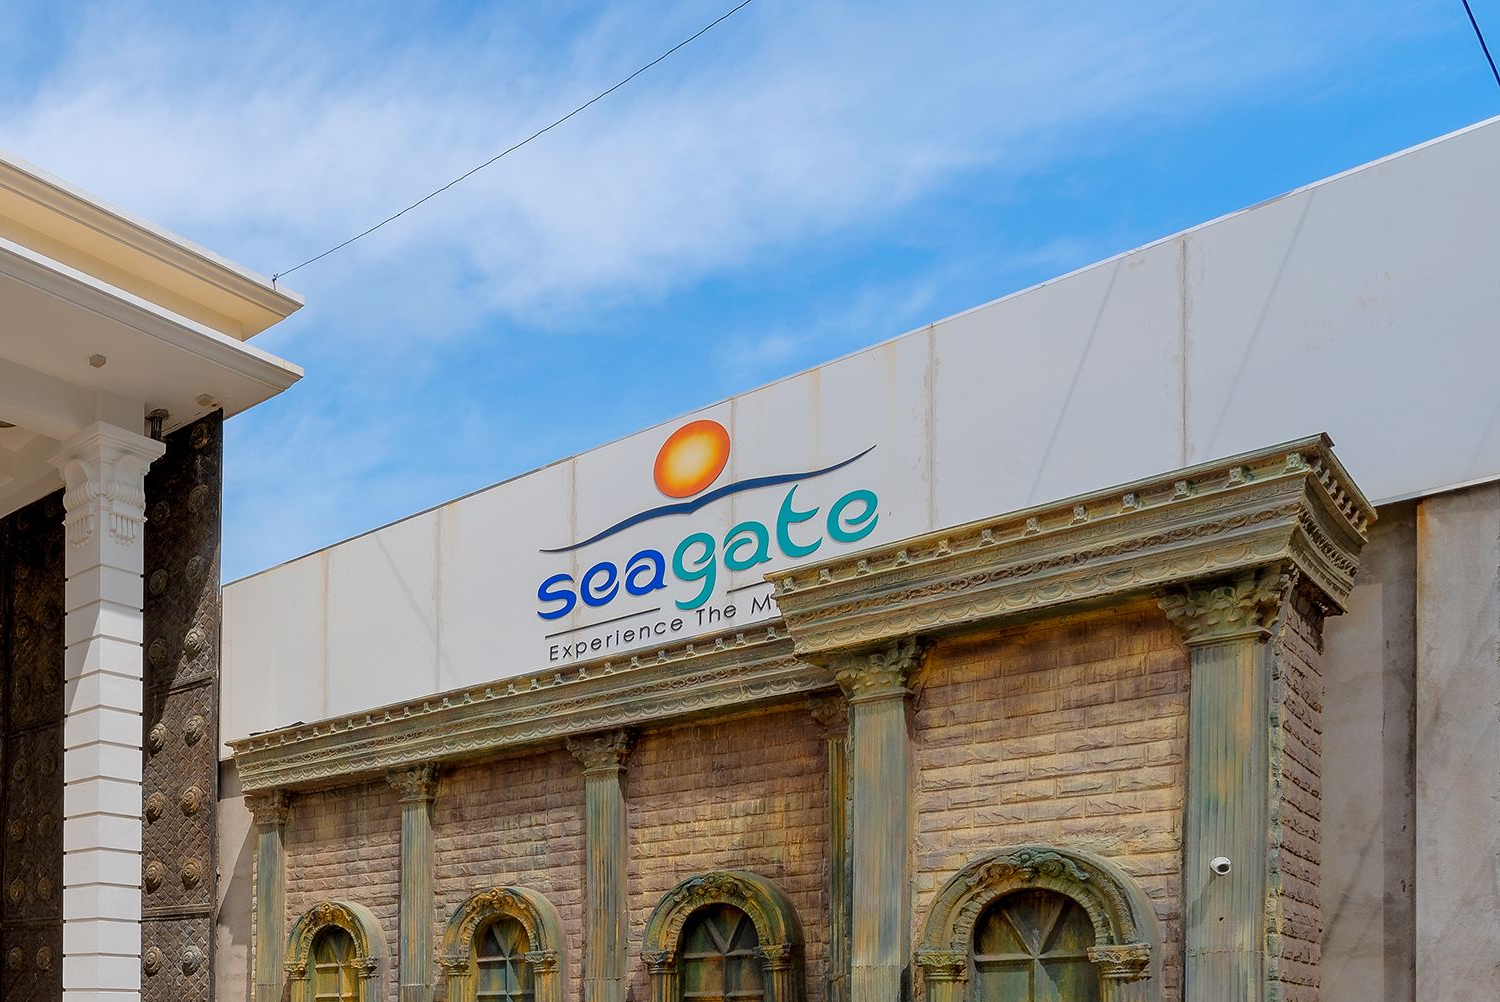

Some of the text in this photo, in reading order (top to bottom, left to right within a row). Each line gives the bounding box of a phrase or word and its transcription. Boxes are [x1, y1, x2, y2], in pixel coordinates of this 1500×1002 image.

[536, 483, 880, 621] seagate
[549, 617, 683, 661] Experience
[695, 603, 737, 627] The
